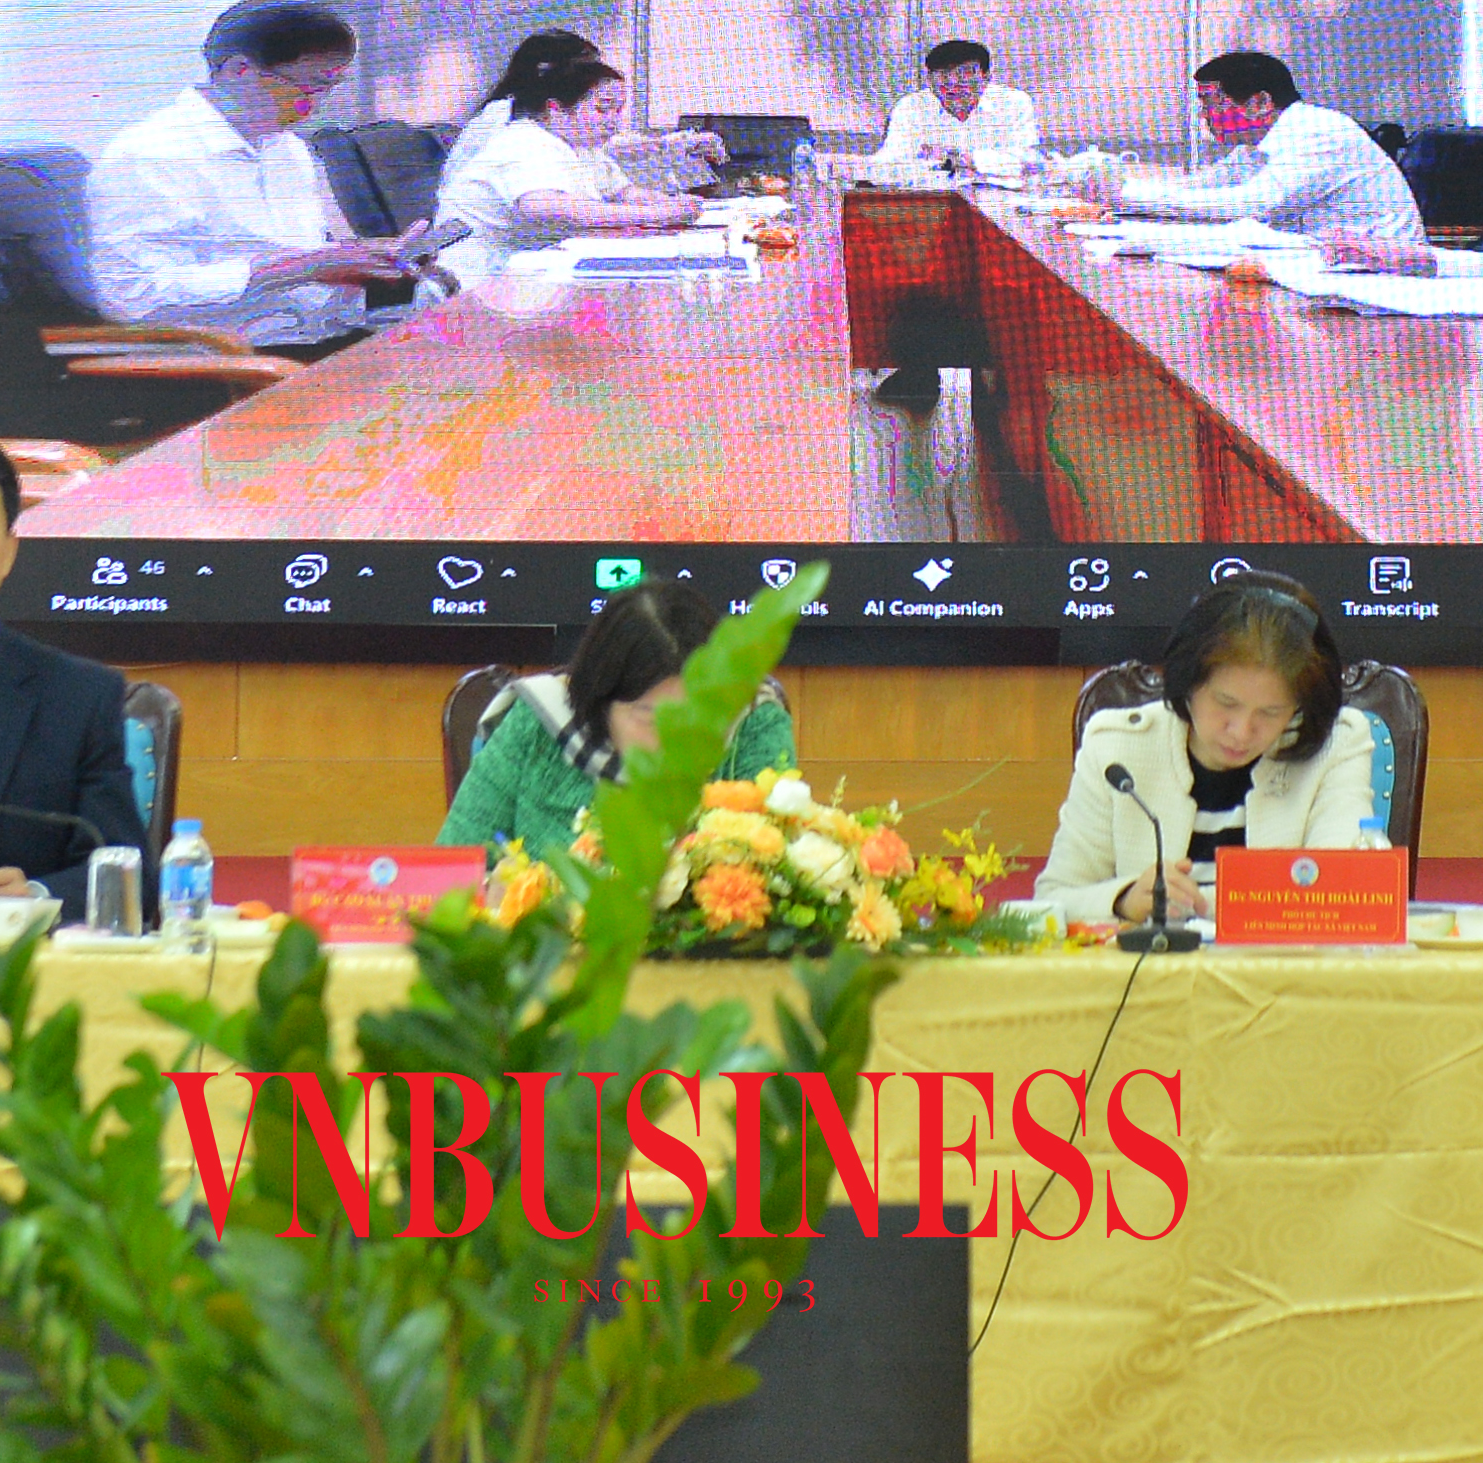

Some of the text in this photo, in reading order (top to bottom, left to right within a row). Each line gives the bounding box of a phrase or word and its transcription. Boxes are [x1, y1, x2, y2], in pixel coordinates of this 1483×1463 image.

[51, 594, 168, 615] Participants
[284, 596, 331, 613] Chat
[432, 597, 487, 614] React
[864, 599, 1005, 619] AI Companion
[1064, 600, 1116, 619] Apps
[1342, 600, 1440, 619] Transcript
